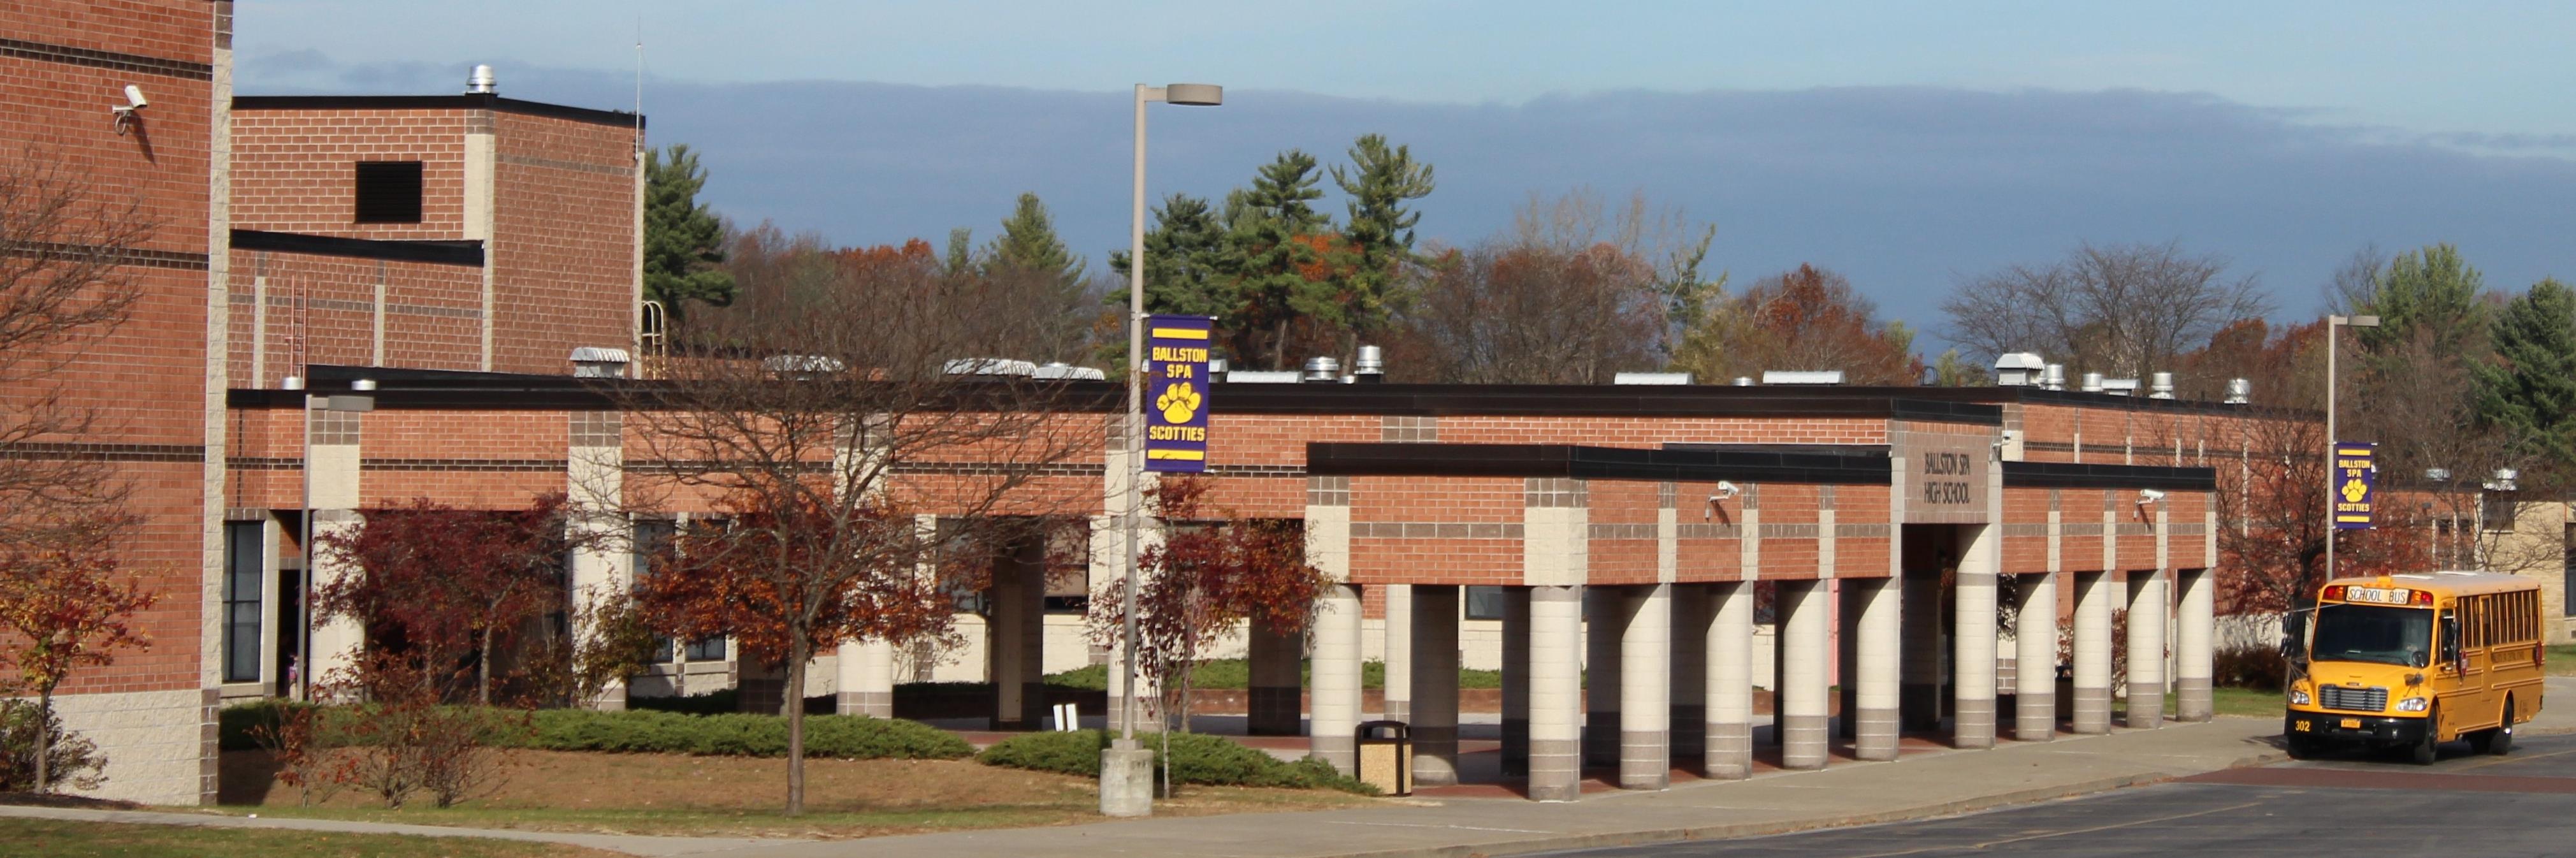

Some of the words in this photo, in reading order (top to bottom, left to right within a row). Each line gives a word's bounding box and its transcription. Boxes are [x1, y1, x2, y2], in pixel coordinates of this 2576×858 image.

[1152, 346, 1208, 363] BALLSTON
[1167, 364, 1192, 379] SPA
[1149, 426, 1205, 442] SCOTTIES
[1925, 452, 1957, 476] BALLSTON
[1959, 453, 1971, 476] SPA
[2338, 460, 2370, 469] BALLSTON
[2347, 469, 2362, 477] SPA
[1924, 481, 1941, 504] HIGH
[1943, 481, 1970, 504] SCHOOL
[2338, 503, 2370, 512] SCOTTIES
[2348, 588, 2382, 602] SCHOOL
[2388, 590, 2406, 603] BUS
[2295, 720, 2310, 732] 302
